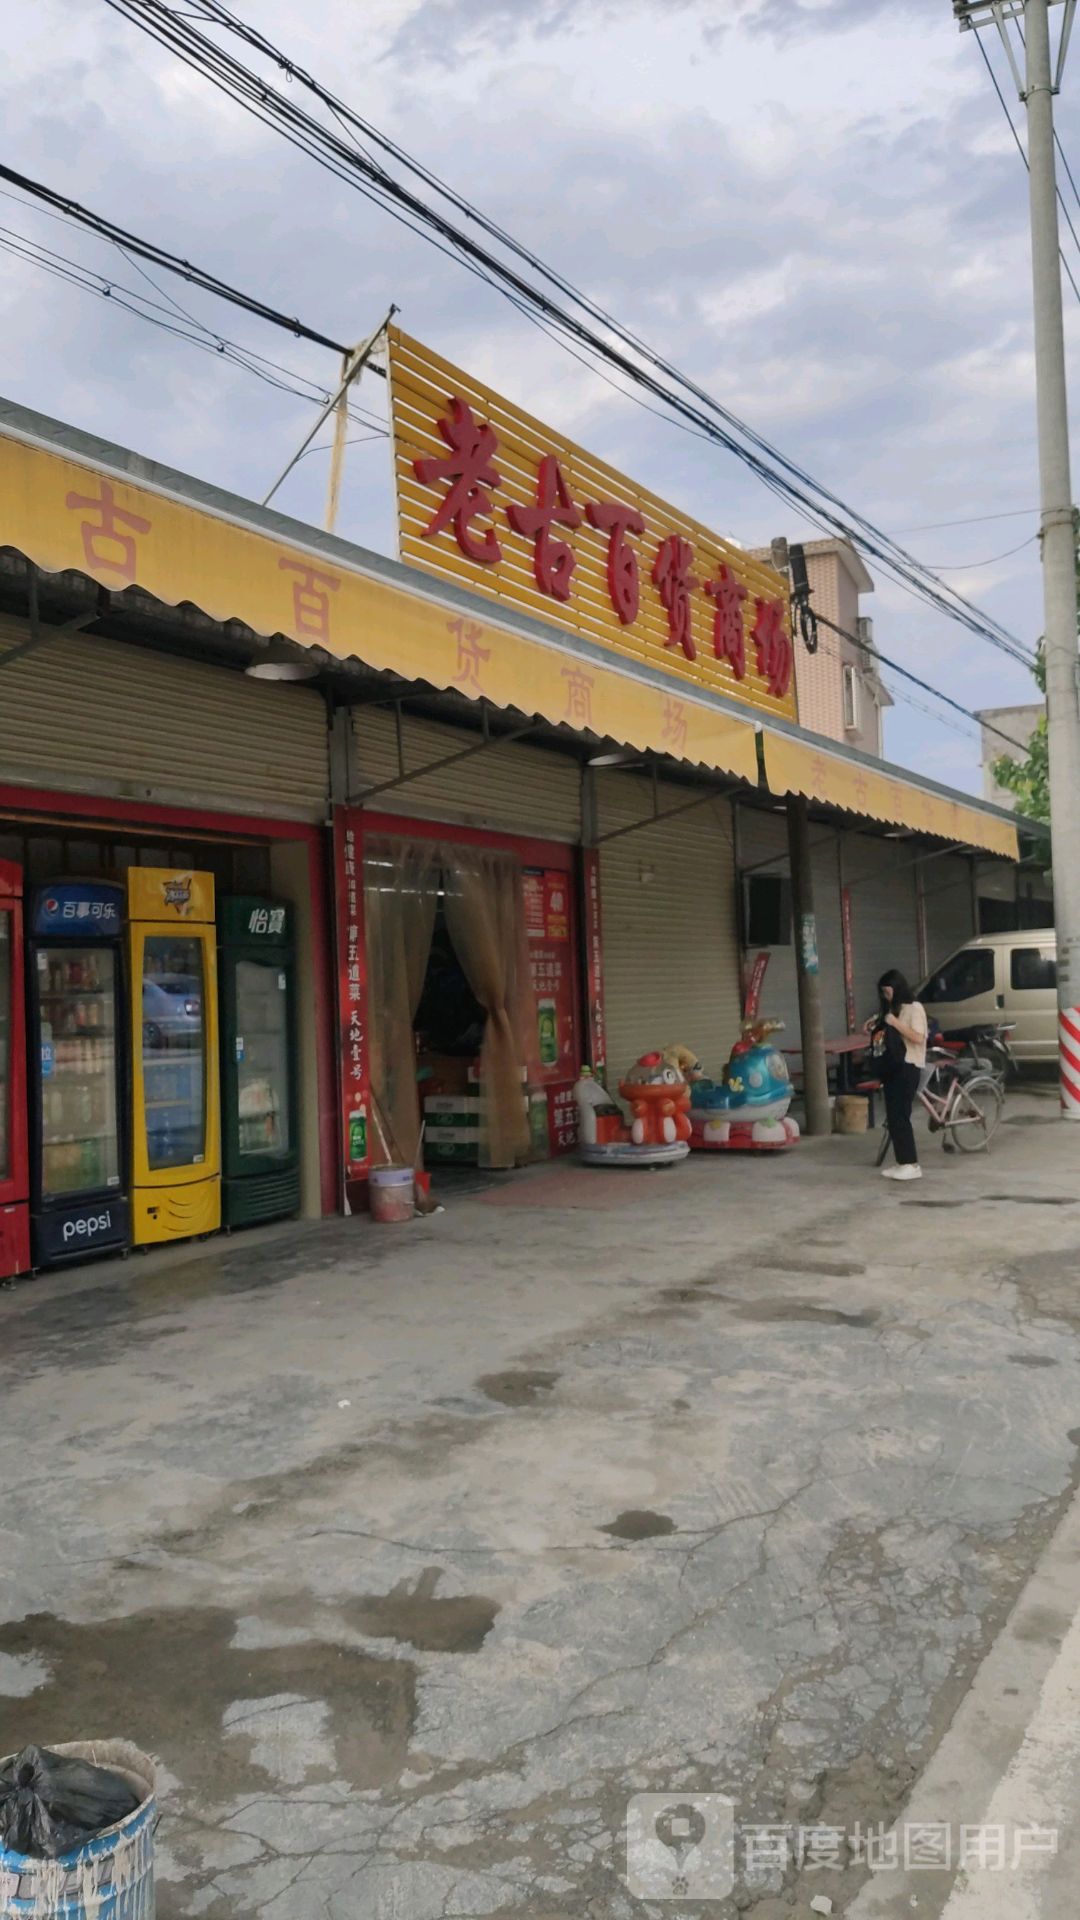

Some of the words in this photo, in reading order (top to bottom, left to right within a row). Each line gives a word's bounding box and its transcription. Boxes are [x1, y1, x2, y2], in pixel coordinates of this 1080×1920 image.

[414, 397, 791, 697] 老古百货商场
[63, 1210, 111, 1241] pepsi
